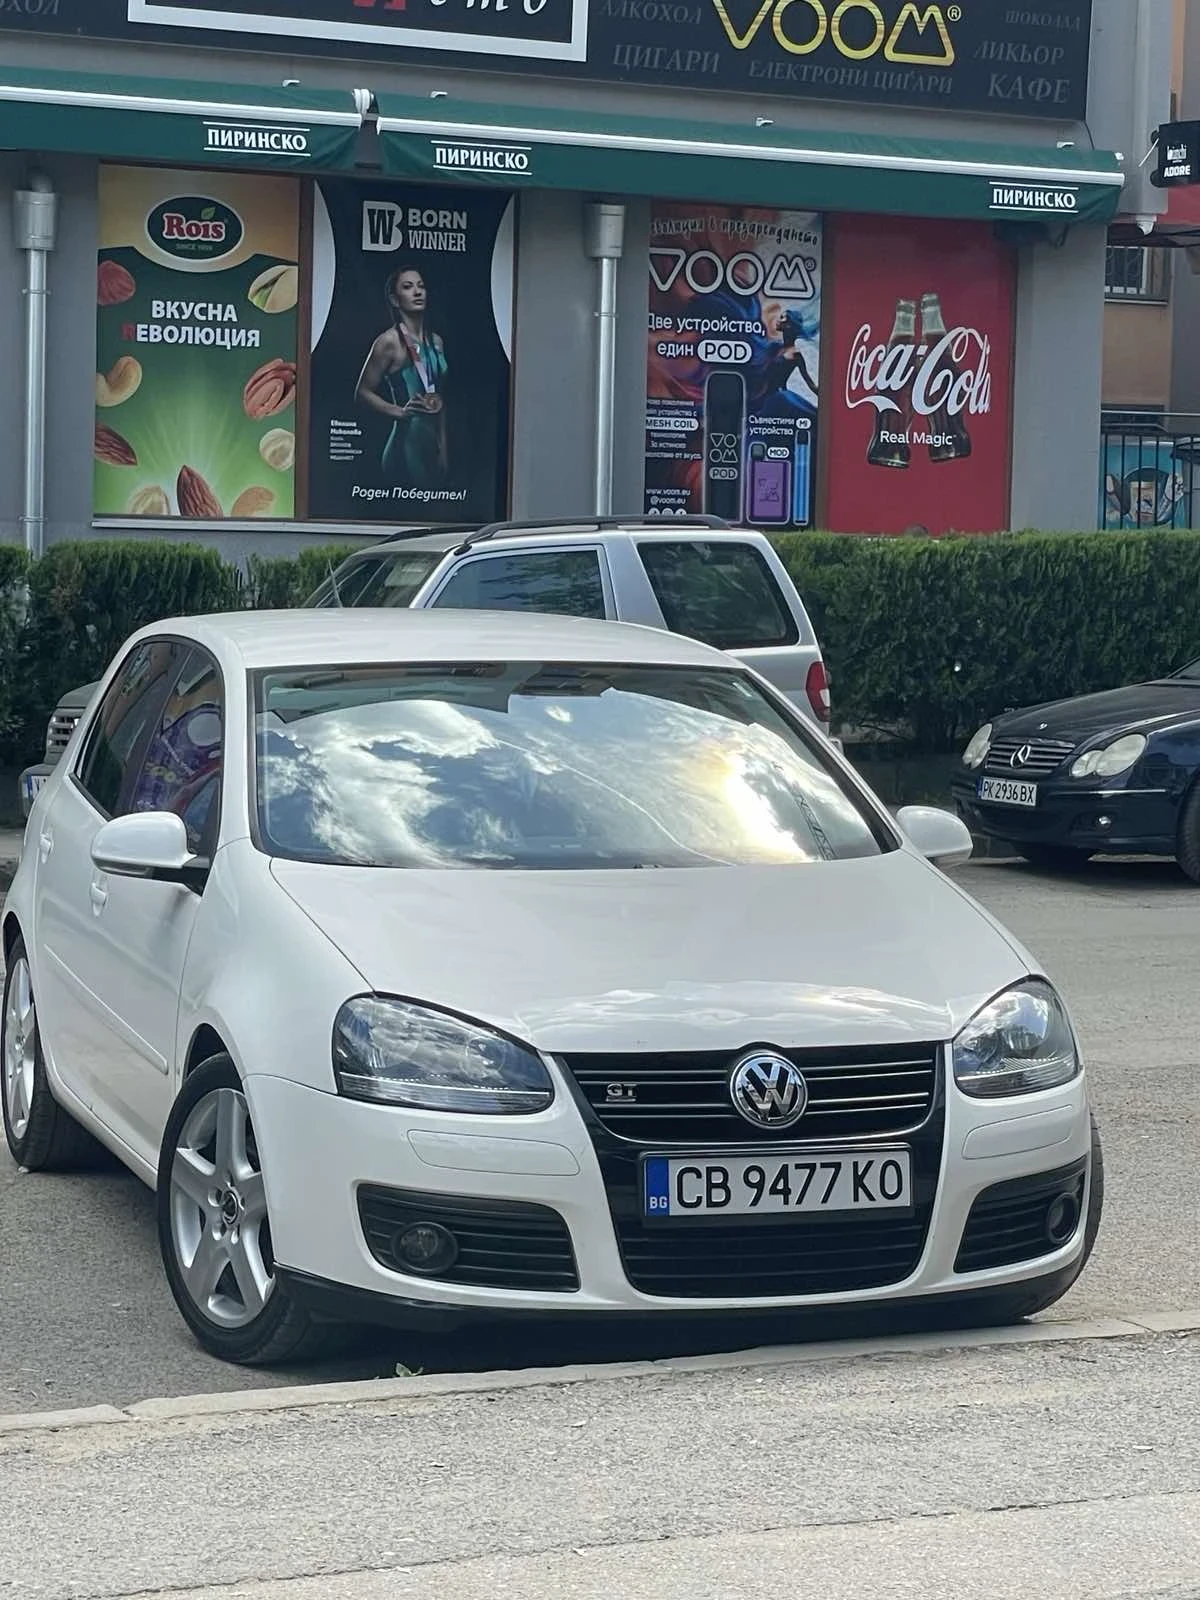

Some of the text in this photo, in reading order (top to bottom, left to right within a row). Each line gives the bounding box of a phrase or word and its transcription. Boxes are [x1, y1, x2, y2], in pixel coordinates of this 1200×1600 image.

[613, 44, 720, 73] ЦИГАРИ
[973, 39, 1064, 65] ЛИКЬОР
[748, 61, 868, 88] ЕЛЕКТРОНИ
[988, 73, 1071, 104] КАФЕ
[207, 128, 308, 151] ПИРИНСКО
[435, 147, 529, 171] ПИРИНСКО
[1163, 165, 1191, 178] ADORE
[992, 187, 1077, 209] ПИРИНСКО
[407, 208, 468, 230] BORN
[407, 229, 467, 252] WINNER
[151, 300, 238, 322] ВКУСНА
[657, 342, 694, 358] един
[704, 342, 748, 361] POD
[845, 323, 992, 416] Coca-Cola
[645, 418, 695, 429] MESH COIL
[879, 430, 910, 445] Real
[711, 469, 737, 480] POD
[351, 485, 467, 502] Роден Победител!
[995, 782, 1019, 801] 2936
[1020, 785, 1035, 804] BX
[606, 1082, 638, 1098] GT
[676, 1165, 732, 1208] CB
[742, 1161, 842, 1207] 9477
[649, 1195, 669, 1209] BG
